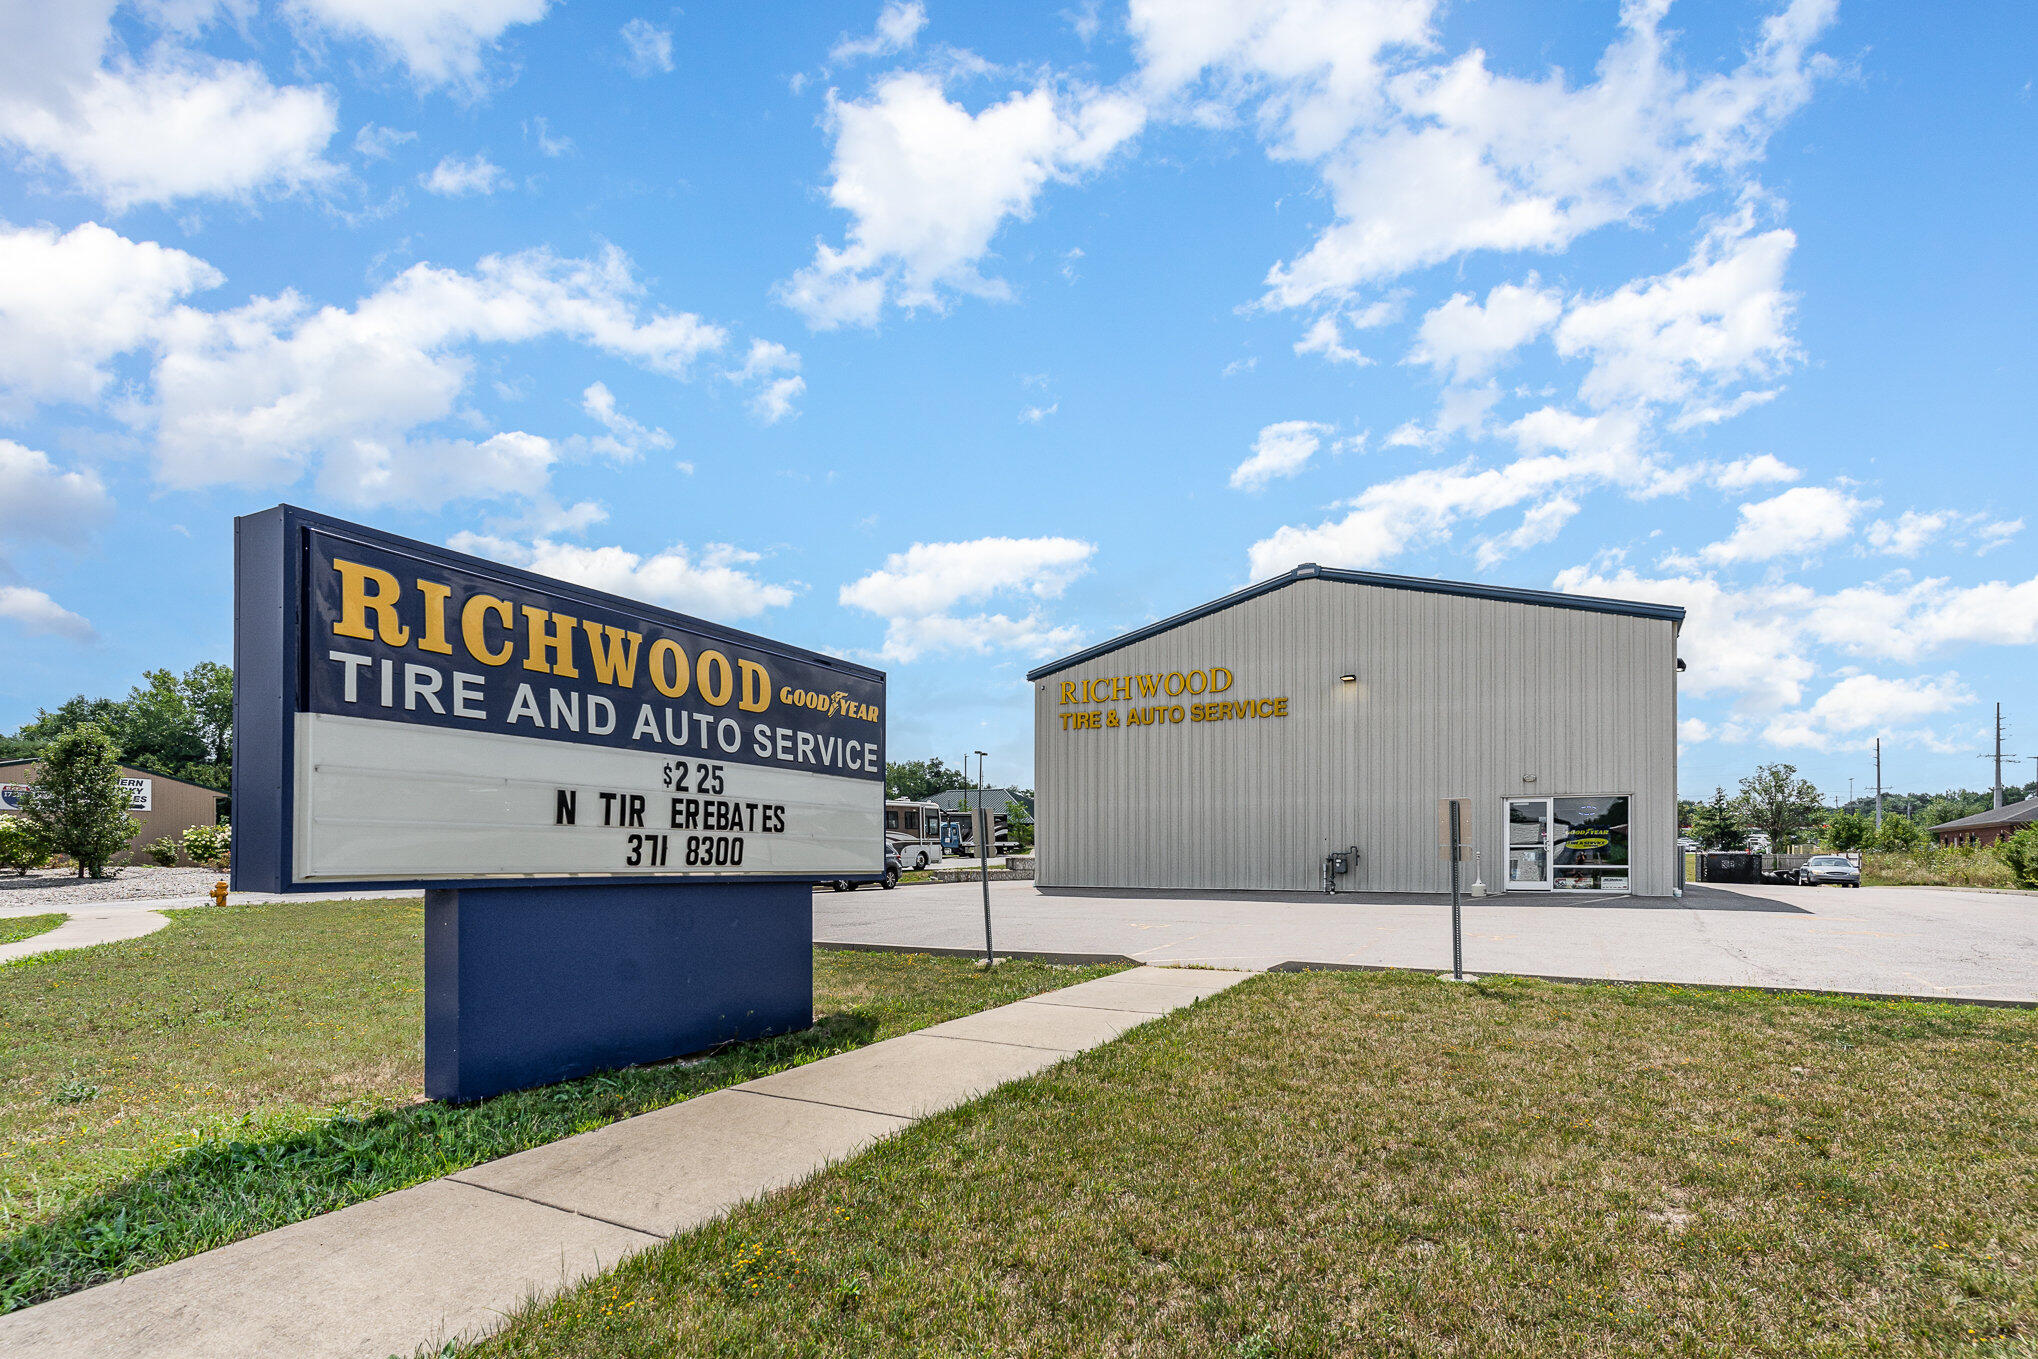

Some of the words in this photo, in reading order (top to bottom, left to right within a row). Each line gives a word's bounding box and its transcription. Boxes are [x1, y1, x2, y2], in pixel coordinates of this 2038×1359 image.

[333, 558, 771, 713] RICHWOOD
[1058, 667, 1233, 704] RICHWOOD
[329, 651, 487, 720] TIRE
[507, 683, 616, 736] AND
[632, 704, 742, 754] AUTO
[753, 724, 878, 773] SERVICE
[1058, 710, 1102, 730] TIRE
[1105, 709, 1120, 727] &
[1126, 704, 1186, 726] AUTO
[1190, 697, 1289, 722] SERVICE
[556, 789, 577, 825] N
[599, 791, 646, 828] TIR
[686, 836, 744, 867] 8300
